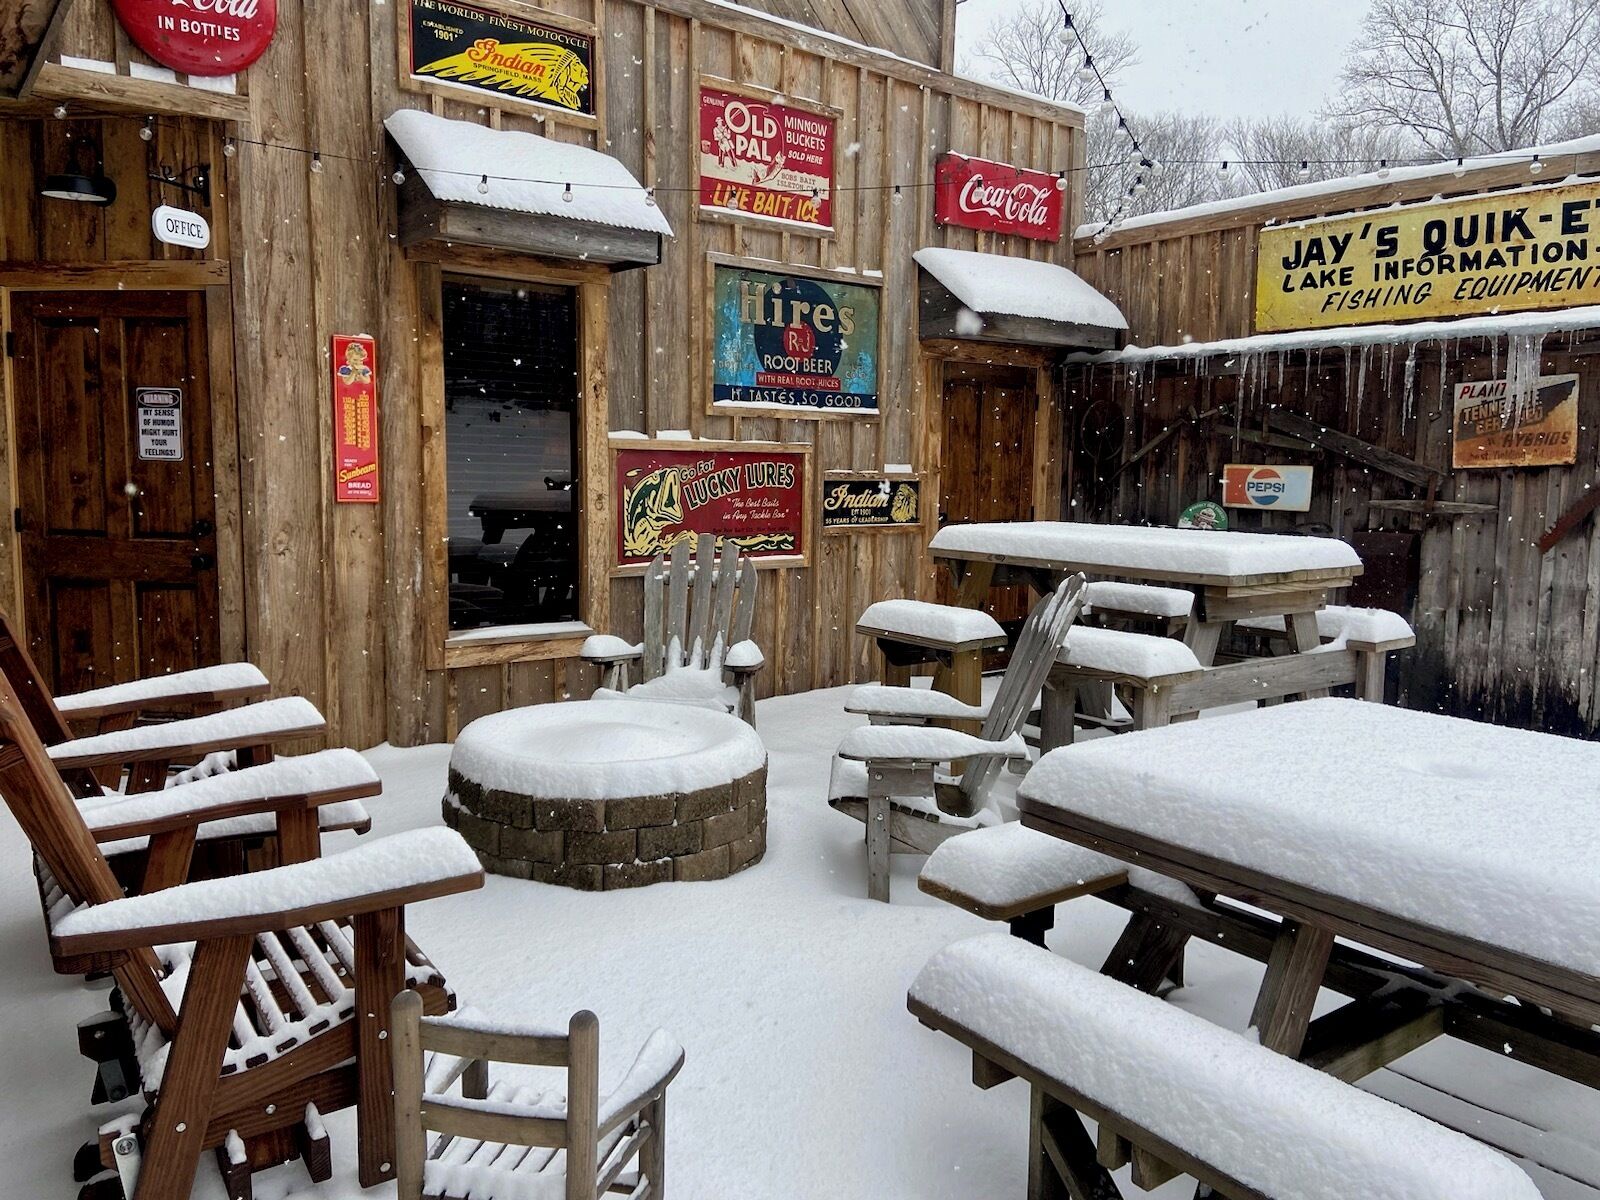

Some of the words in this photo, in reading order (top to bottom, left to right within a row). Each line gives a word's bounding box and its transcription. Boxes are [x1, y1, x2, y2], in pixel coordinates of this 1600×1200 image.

[158, 15, 175, 31] IN
[180, 19, 241, 42] BOTTLES
[434, 29, 454, 41] 1901
[437, 3, 485, 22] WORLDS
[489, 16, 524, 32] FINEST
[526, 25, 589, 49] MOTOCYCLE
[466, 38, 547, 79] Indian
[703, 96, 725, 108] GENUINE
[724, 101, 778, 139] OLD
[784, 116, 828, 137] MINNOW
[735, 133, 772, 162] PAL
[786, 131, 826, 152] BUCKETS
[788, 150, 805, 161] SOLD
[806, 154, 824, 165] HERE
[713, 182, 751, 210] LIVE
[796, 198, 819, 223] ICE
[959, 173, 1053, 226] Coca-Cola
[166, 218, 203, 239] OFFICE
[1281, 222, 1399, 271] JAY'S
[1423, 198, 1600, 257] QUIK-E
[1282, 266, 1355, 293] LAKE
[1374, 238, 1588, 282] INFORMATION
[740, 280, 856, 336] Hires
[1321, 282, 1433, 313] FISHING
[764, 354, 800, 372] ROOT
[803, 358, 833, 375] BEER
[757, 374, 776, 384] WITH
[777, 376, 795, 386] REAL
[796, 378, 815, 387] ROOT
[1459, 382, 1507, 400] PLANT
[749, 389, 795, 405] TASTES
[802, 391, 819, 406] SO
[825, 394, 862, 408] GOOD
[143, 418, 151, 426] OF
[152, 419, 175, 427] HUMOR
[154, 409, 175, 417] SENSE
[141, 428, 161, 436] MIGHT
[162, 429, 178, 437] HURT
[1502, 431, 1572, 448] HYBRIDS
[145, 449, 176, 457] FEELINGS!
[339, 463, 376, 483] Sunbeam
[680, 467, 696, 482] Go
[697, 459, 716, 476] For
[683, 466, 742, 511] LUCKY
[745, 461, 795, 490] LURES
[1247, 482, 1285, 493] PEPSI
[745, 497, 761, 508] Best
[761, 497, 780, 508] Baits
[824, 483, 890, 511] Indian
[722, 511, 731, 520] in
[732, 509, 748, 522] Any
[749, 509, 771, 520] Tackle
